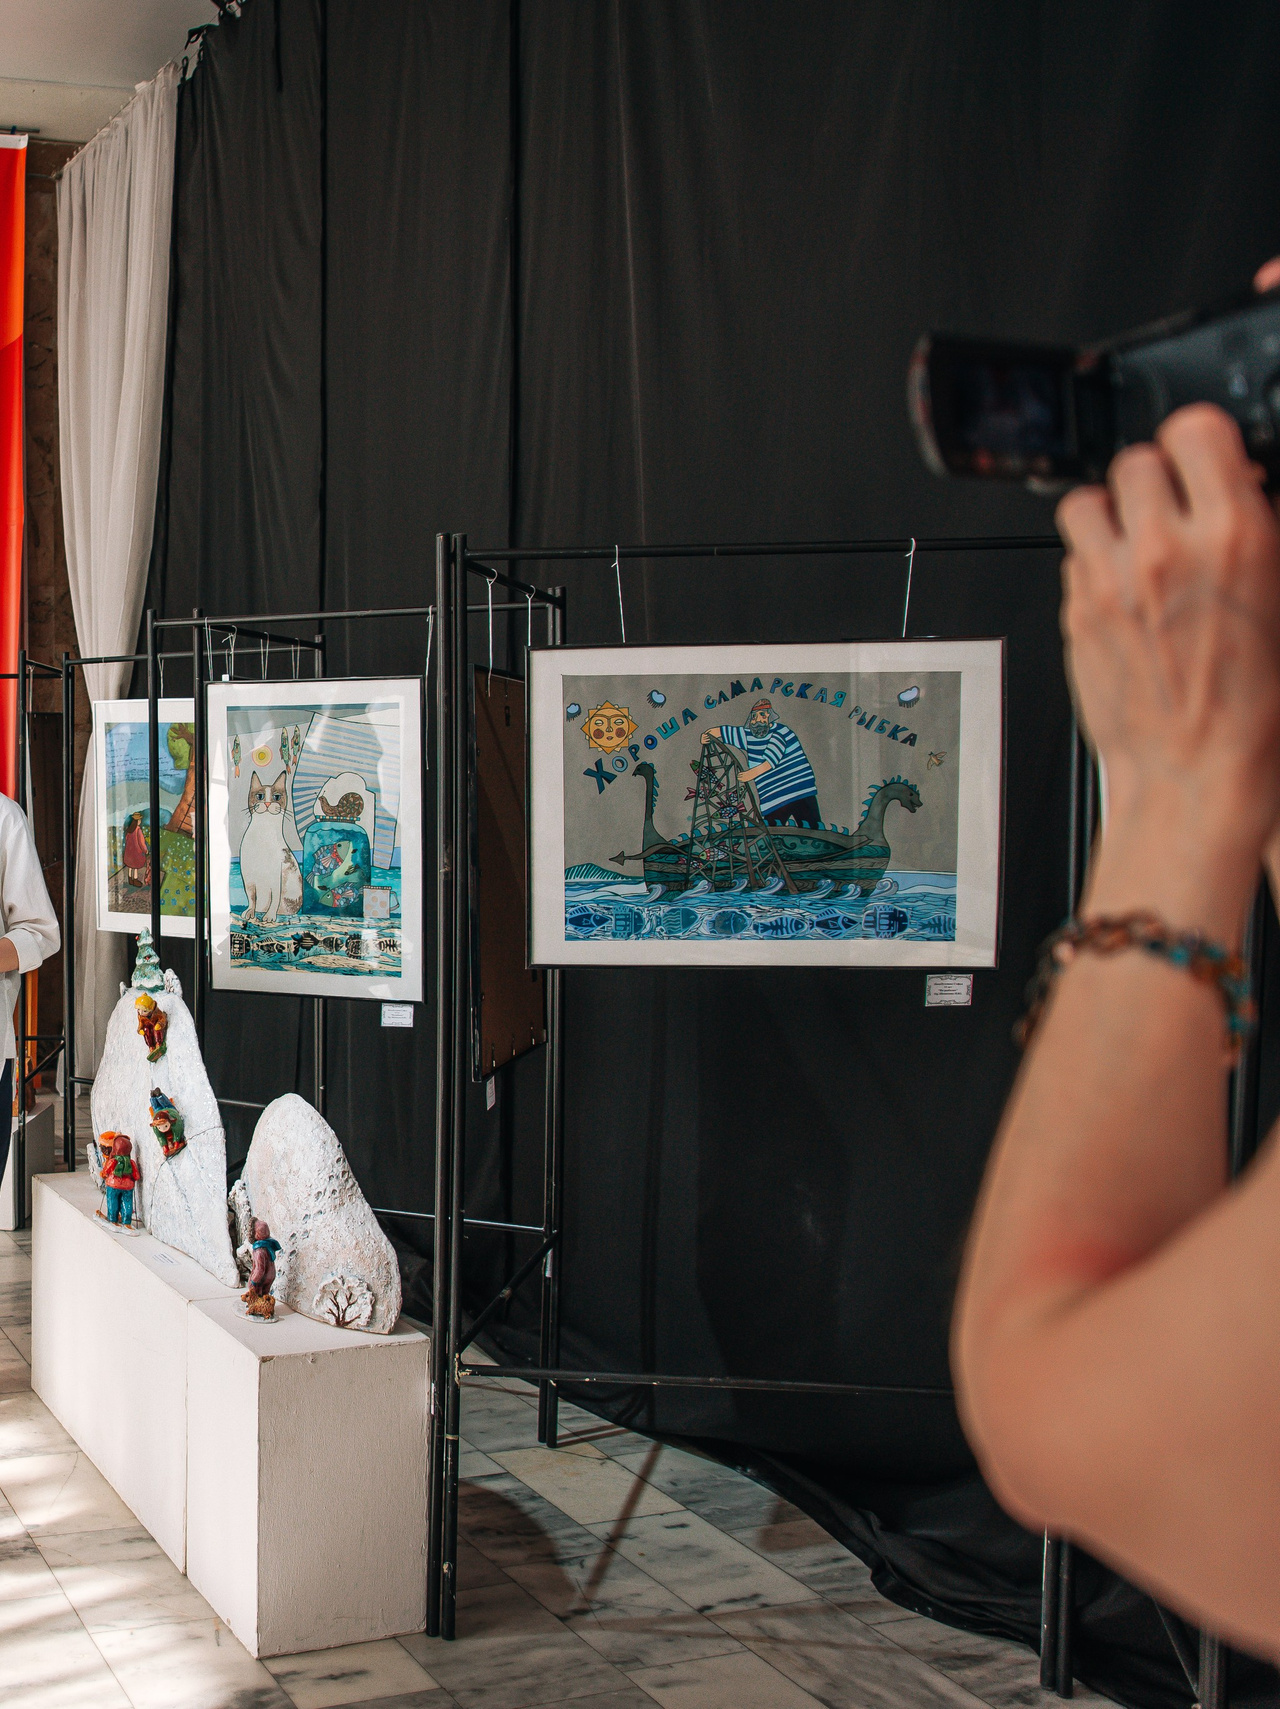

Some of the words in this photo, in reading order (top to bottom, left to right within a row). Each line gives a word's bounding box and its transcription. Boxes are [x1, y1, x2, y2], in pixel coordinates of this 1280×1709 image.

[582, 707, 699, 795] ХОРОША
[703, 677, 847, 710] САМАРСКАЯ
[847, 705, 919, 748] РЫБКА
